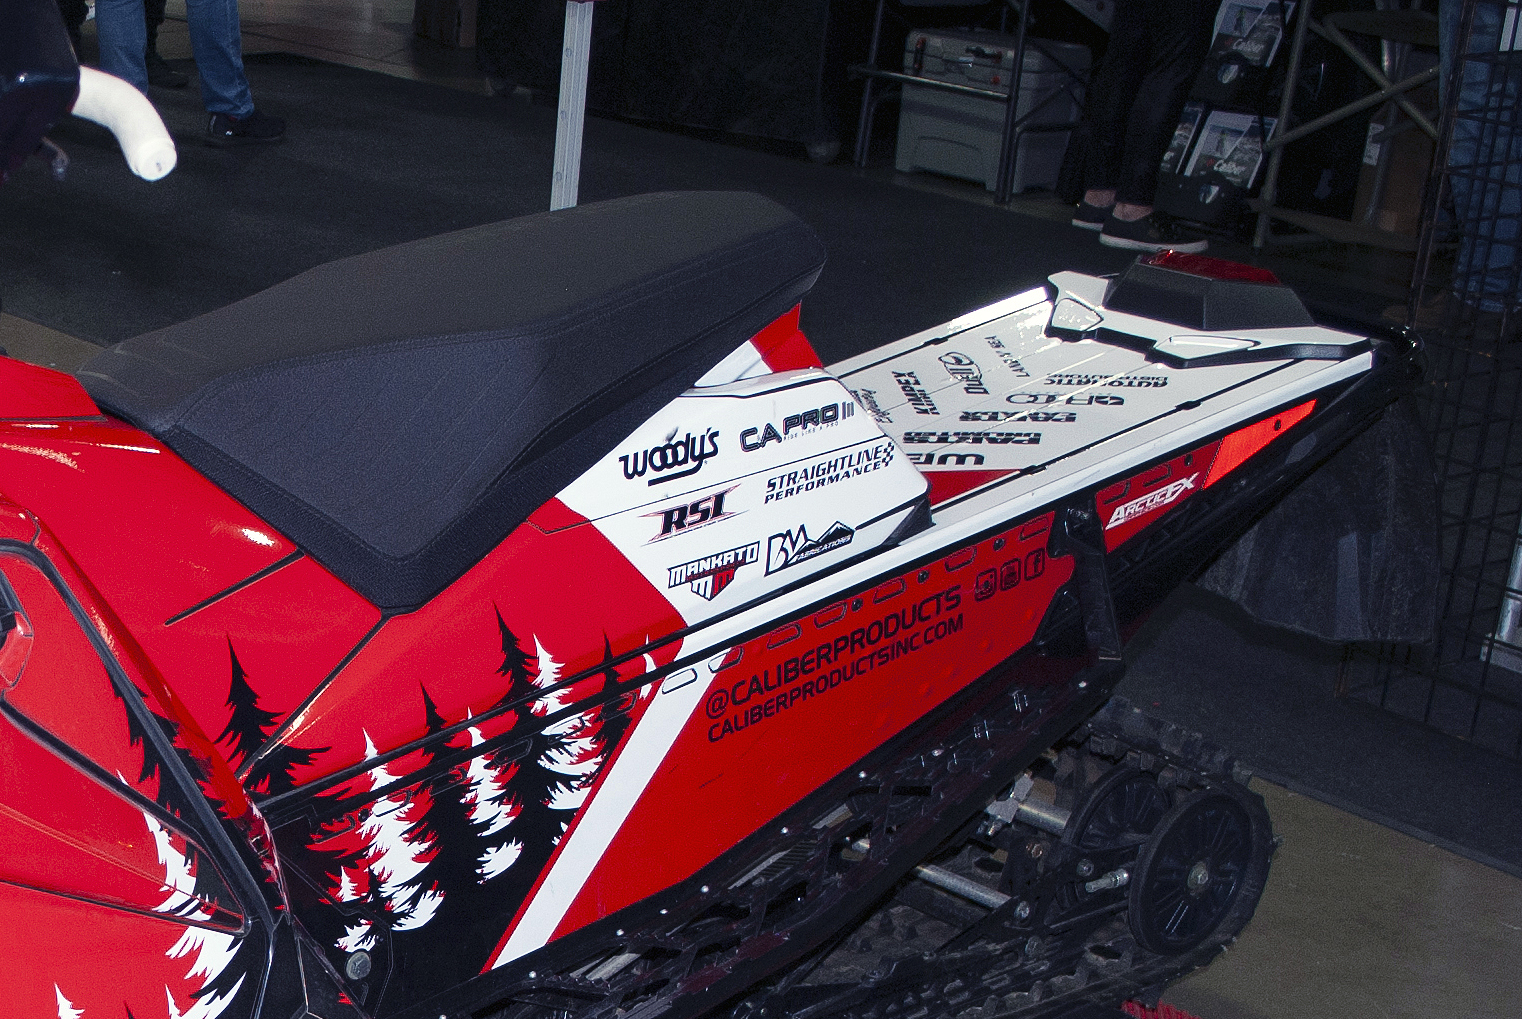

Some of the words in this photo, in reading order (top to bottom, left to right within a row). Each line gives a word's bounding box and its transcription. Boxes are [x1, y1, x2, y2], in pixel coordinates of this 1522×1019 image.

[783, 403, 839, 436] PRO
[764, 460, 881, 504] PERFORMANCE
[766, 444, 883, 493] STRAIGHTLINE
[654, 488, 732, 538] RSI
[669, 542, 759, 587] MANKATO
[706, 585, 962, 719] @CALIBERPRODUCTS
[708, 613, 964, 743] CALIBERPRODUCTSINC.COM
